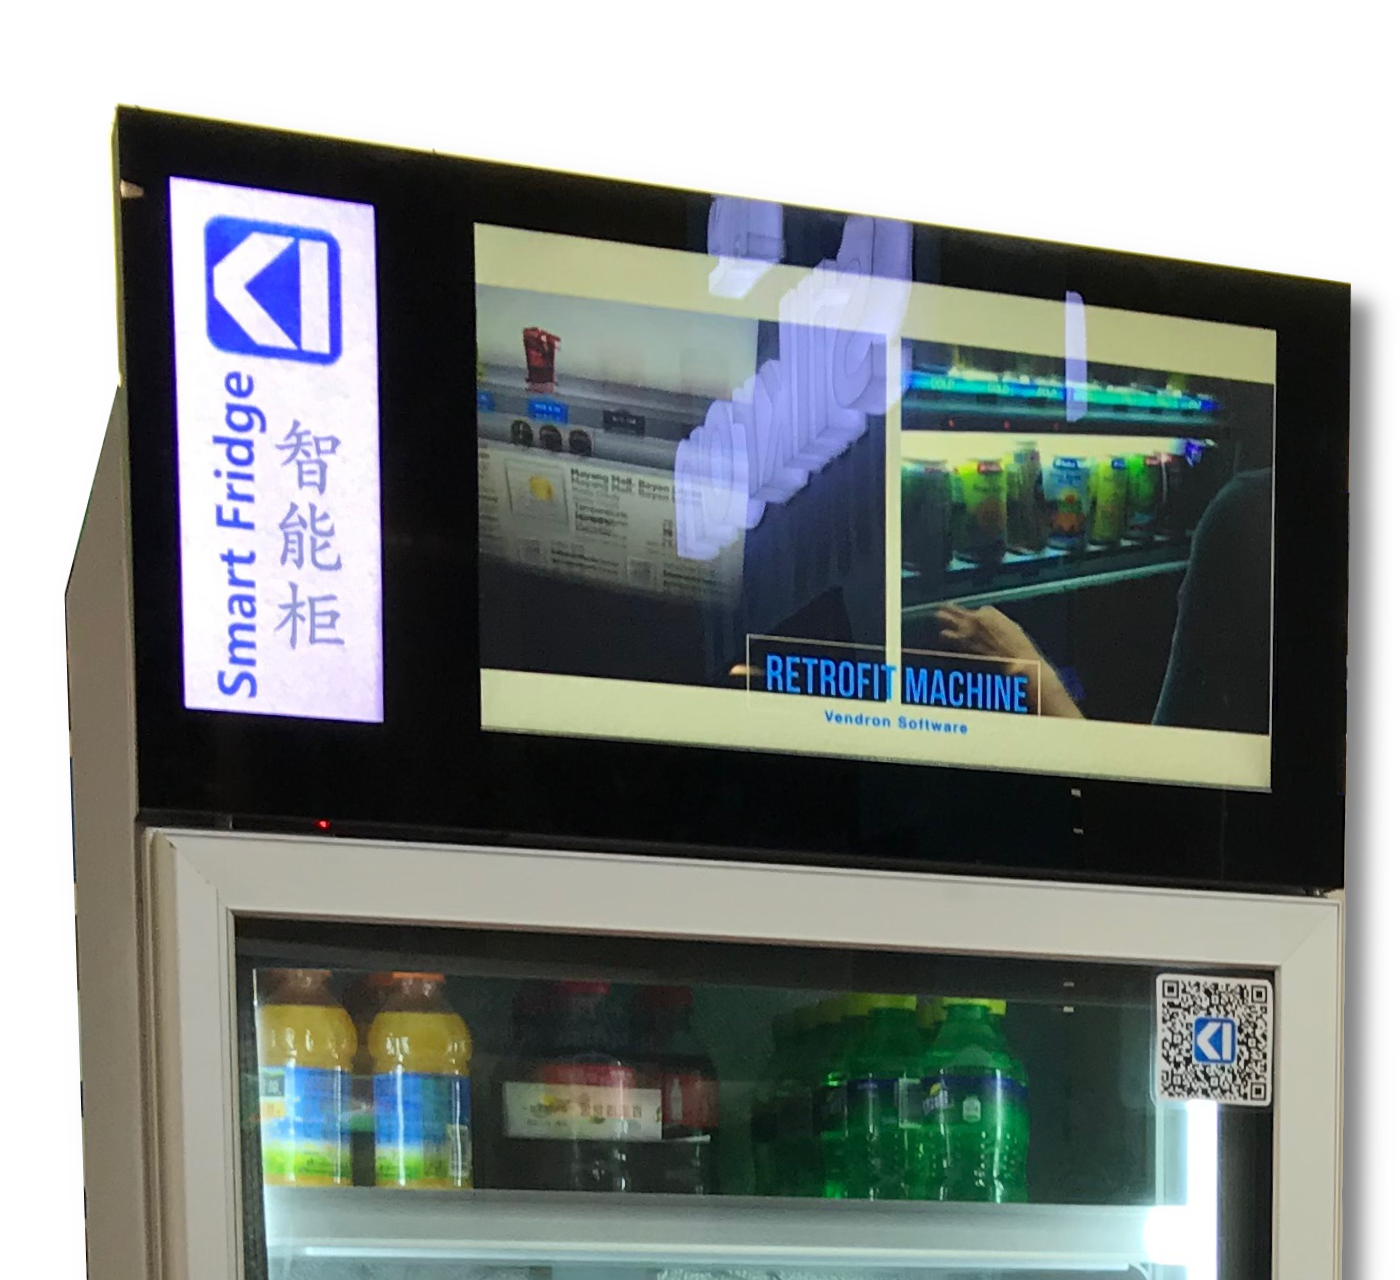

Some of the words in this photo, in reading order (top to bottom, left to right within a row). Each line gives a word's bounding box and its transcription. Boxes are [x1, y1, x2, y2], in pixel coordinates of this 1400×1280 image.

[212, 371, 266, 530] Fridge
[274, 418, 345, 650] 智能柜
[217, 548, 257, 698] Smart
[766, 653, 897, 702] RETROFIT
[905, 667, 1028, 713] MACHINE
[824, 709, 891, 728] Vendron
[898, 715, 968, 735] Software
